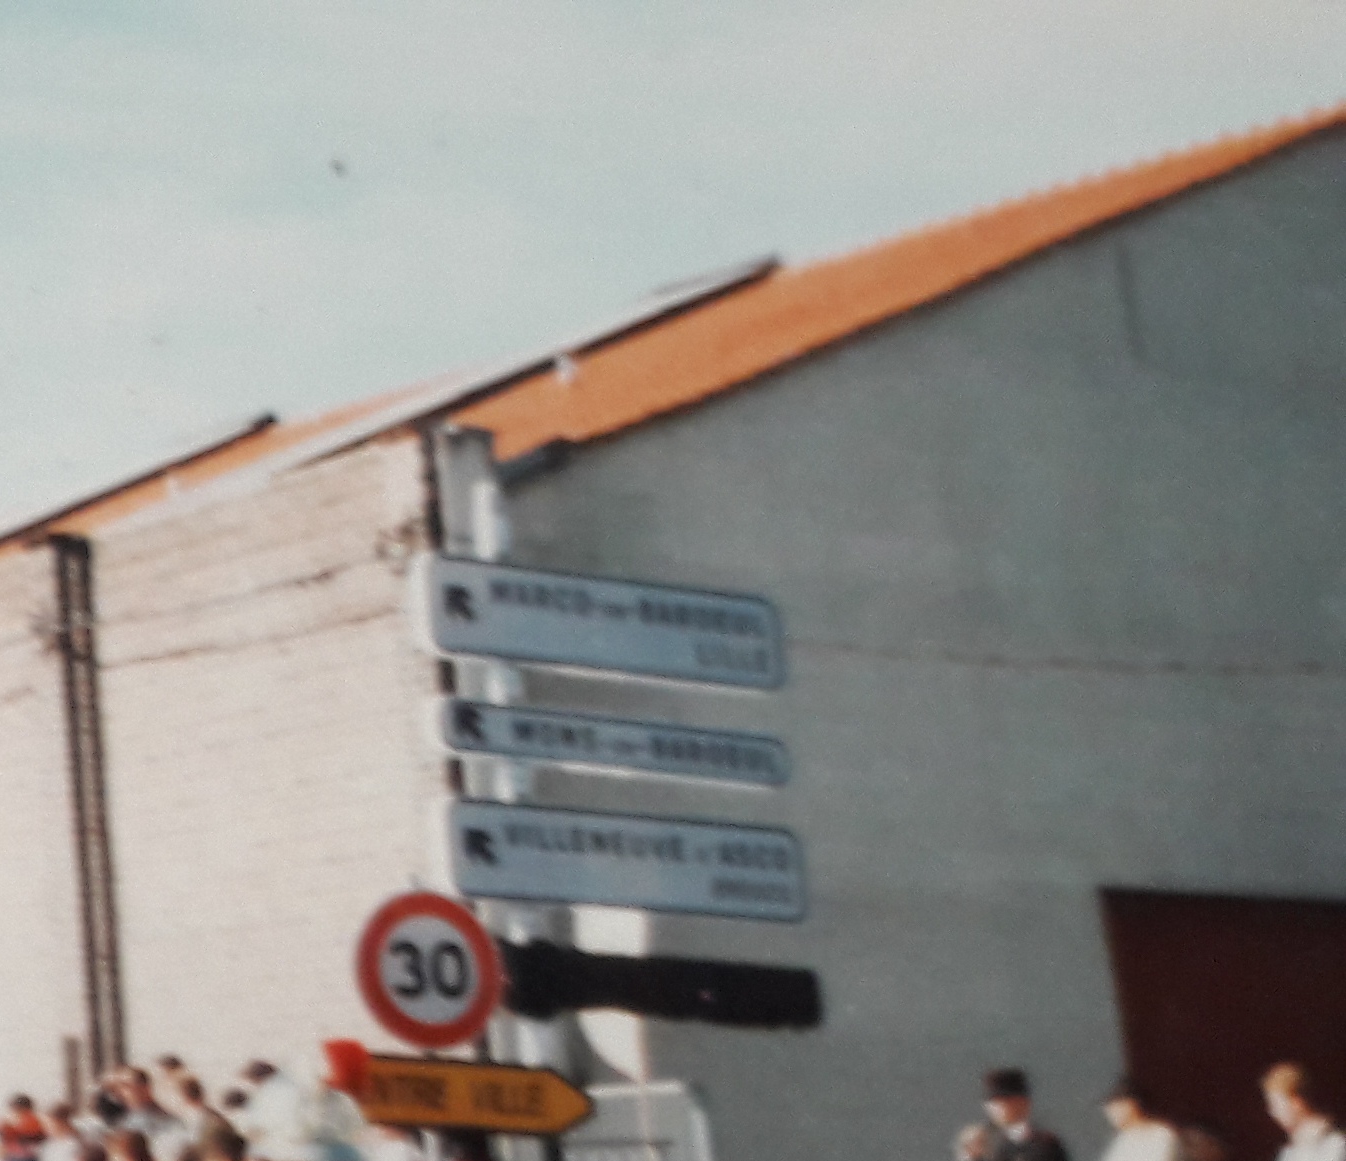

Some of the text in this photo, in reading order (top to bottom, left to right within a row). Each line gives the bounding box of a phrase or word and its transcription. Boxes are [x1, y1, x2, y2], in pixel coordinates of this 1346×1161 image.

[503, 823, 686, 864] VILLENEUVE
[388, 939, 469, 1000] 30
[471, 1078, 545, 1118] VILLE
